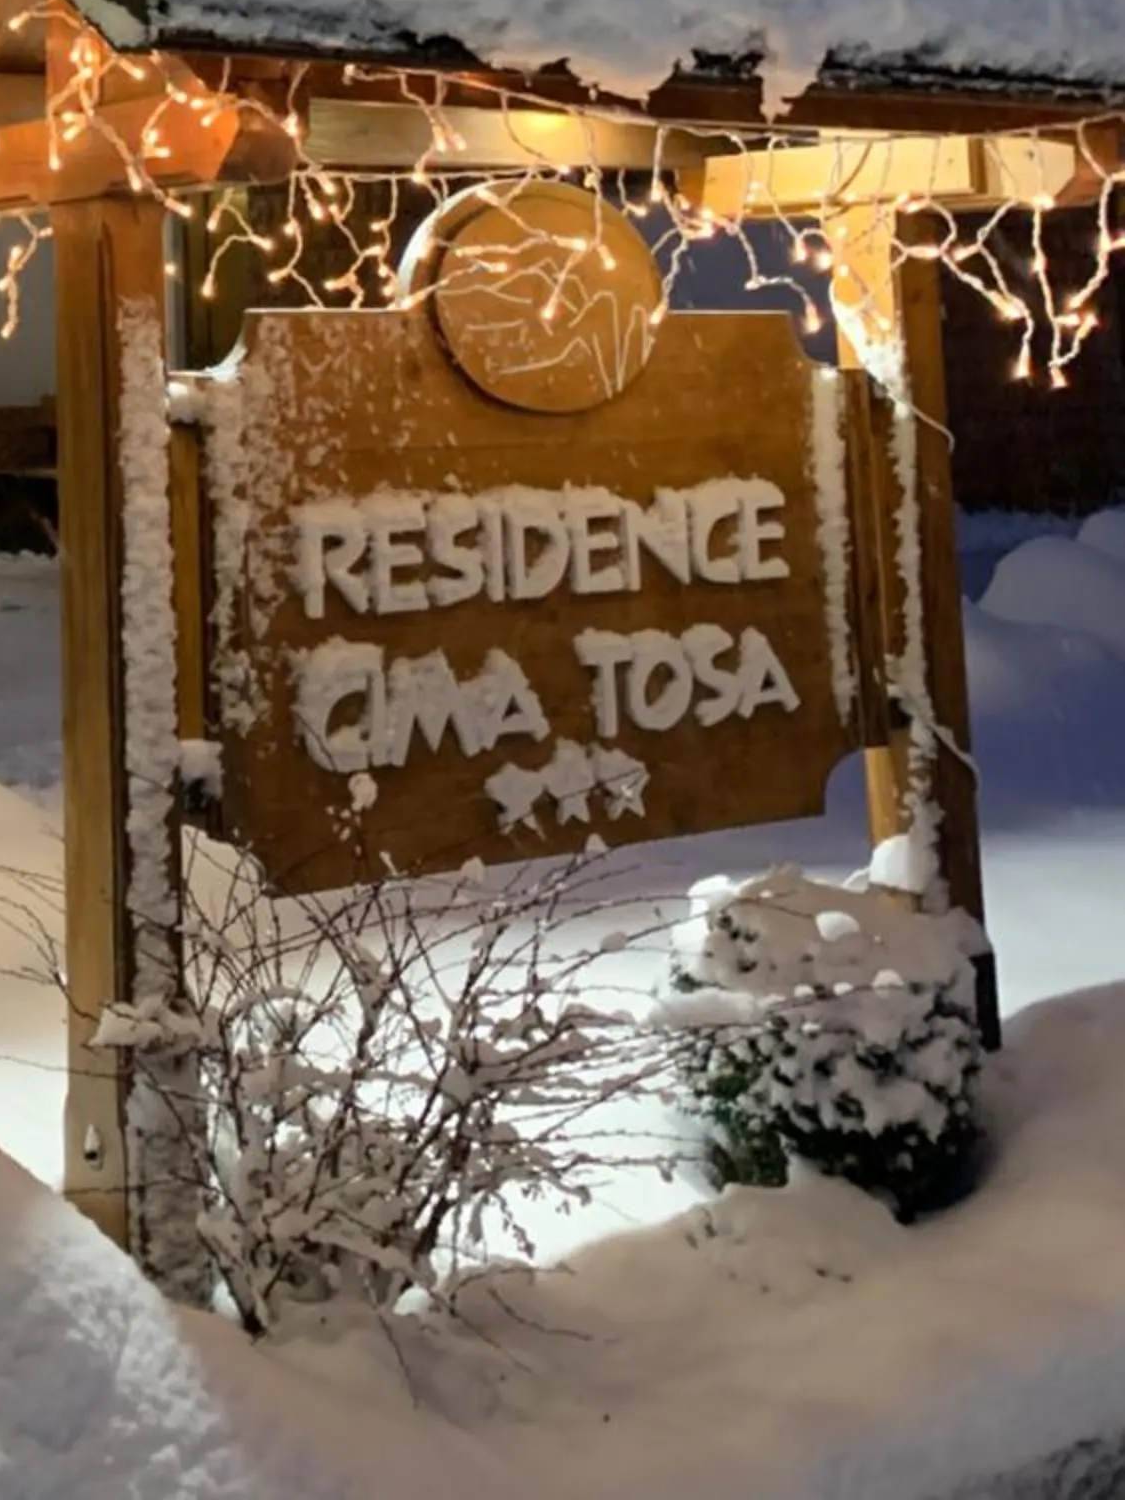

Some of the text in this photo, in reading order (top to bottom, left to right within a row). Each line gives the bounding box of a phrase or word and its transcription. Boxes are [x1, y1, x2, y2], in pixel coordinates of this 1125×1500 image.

[289, 476, 789, 619] RESIDENCE
[294, 624, 800, 773] CIMA TOSA
